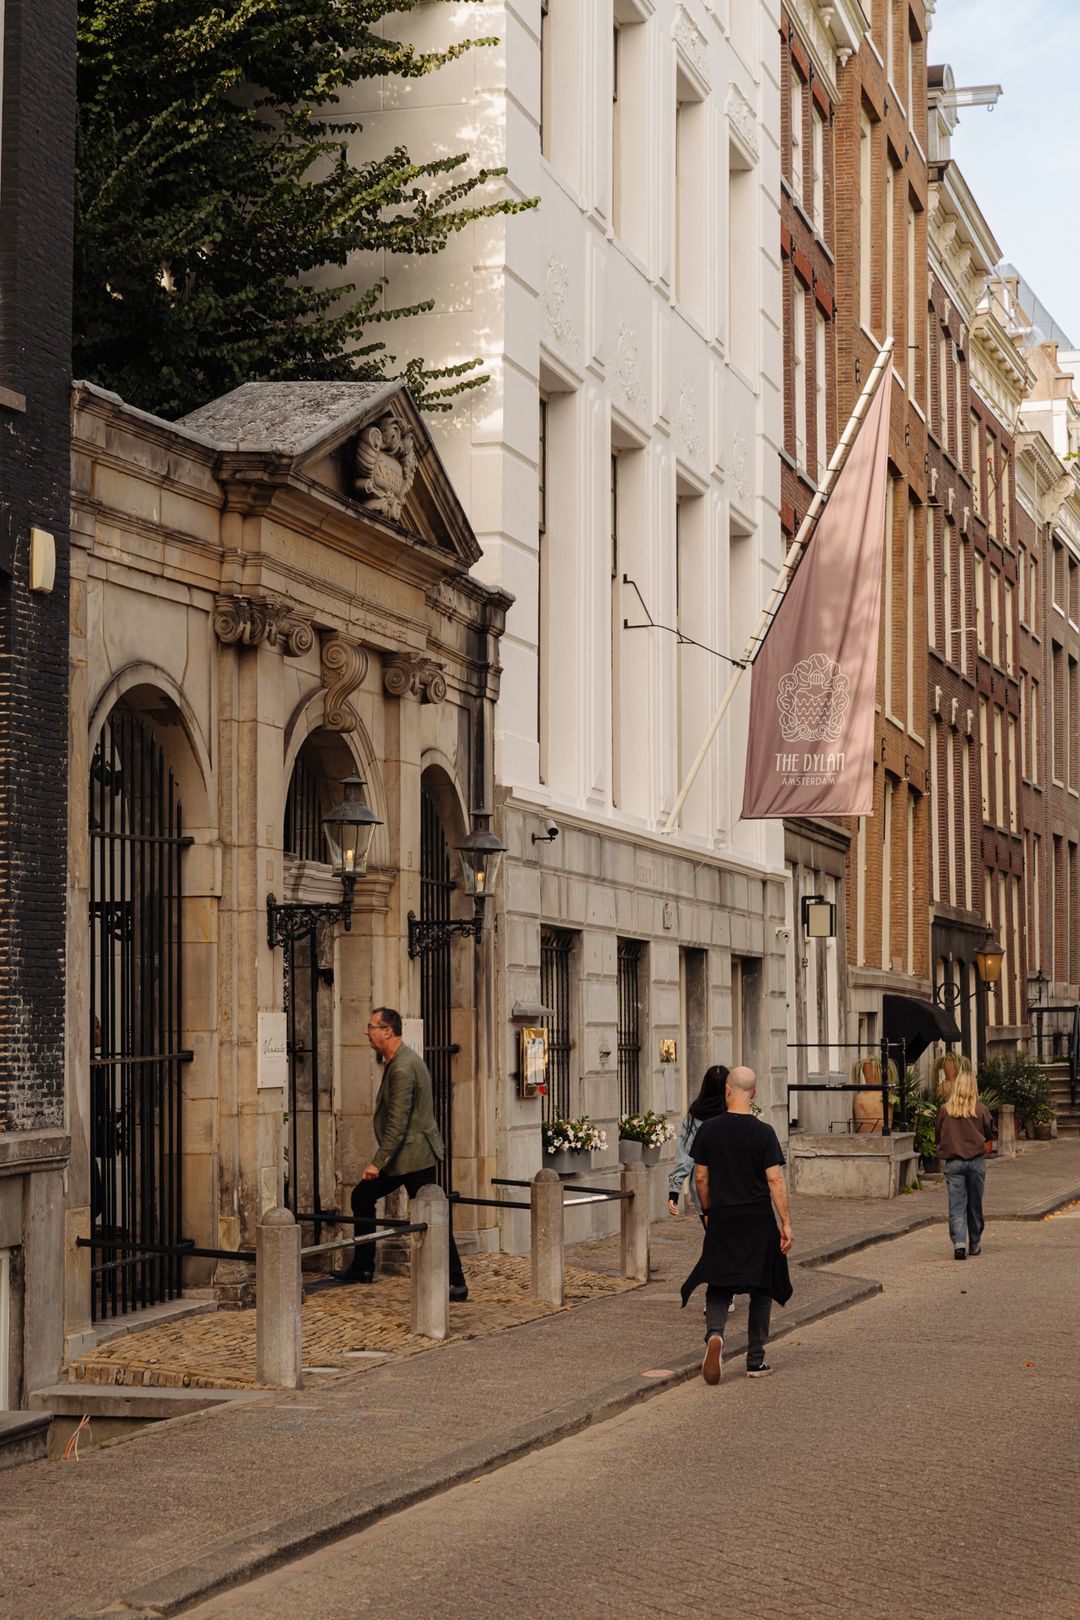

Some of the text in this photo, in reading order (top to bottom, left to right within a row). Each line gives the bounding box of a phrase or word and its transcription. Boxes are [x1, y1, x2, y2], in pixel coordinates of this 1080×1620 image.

[774, 752, 845, 772] THE DYLAN
[782, 777, 836, 786] AMSTERDAM
